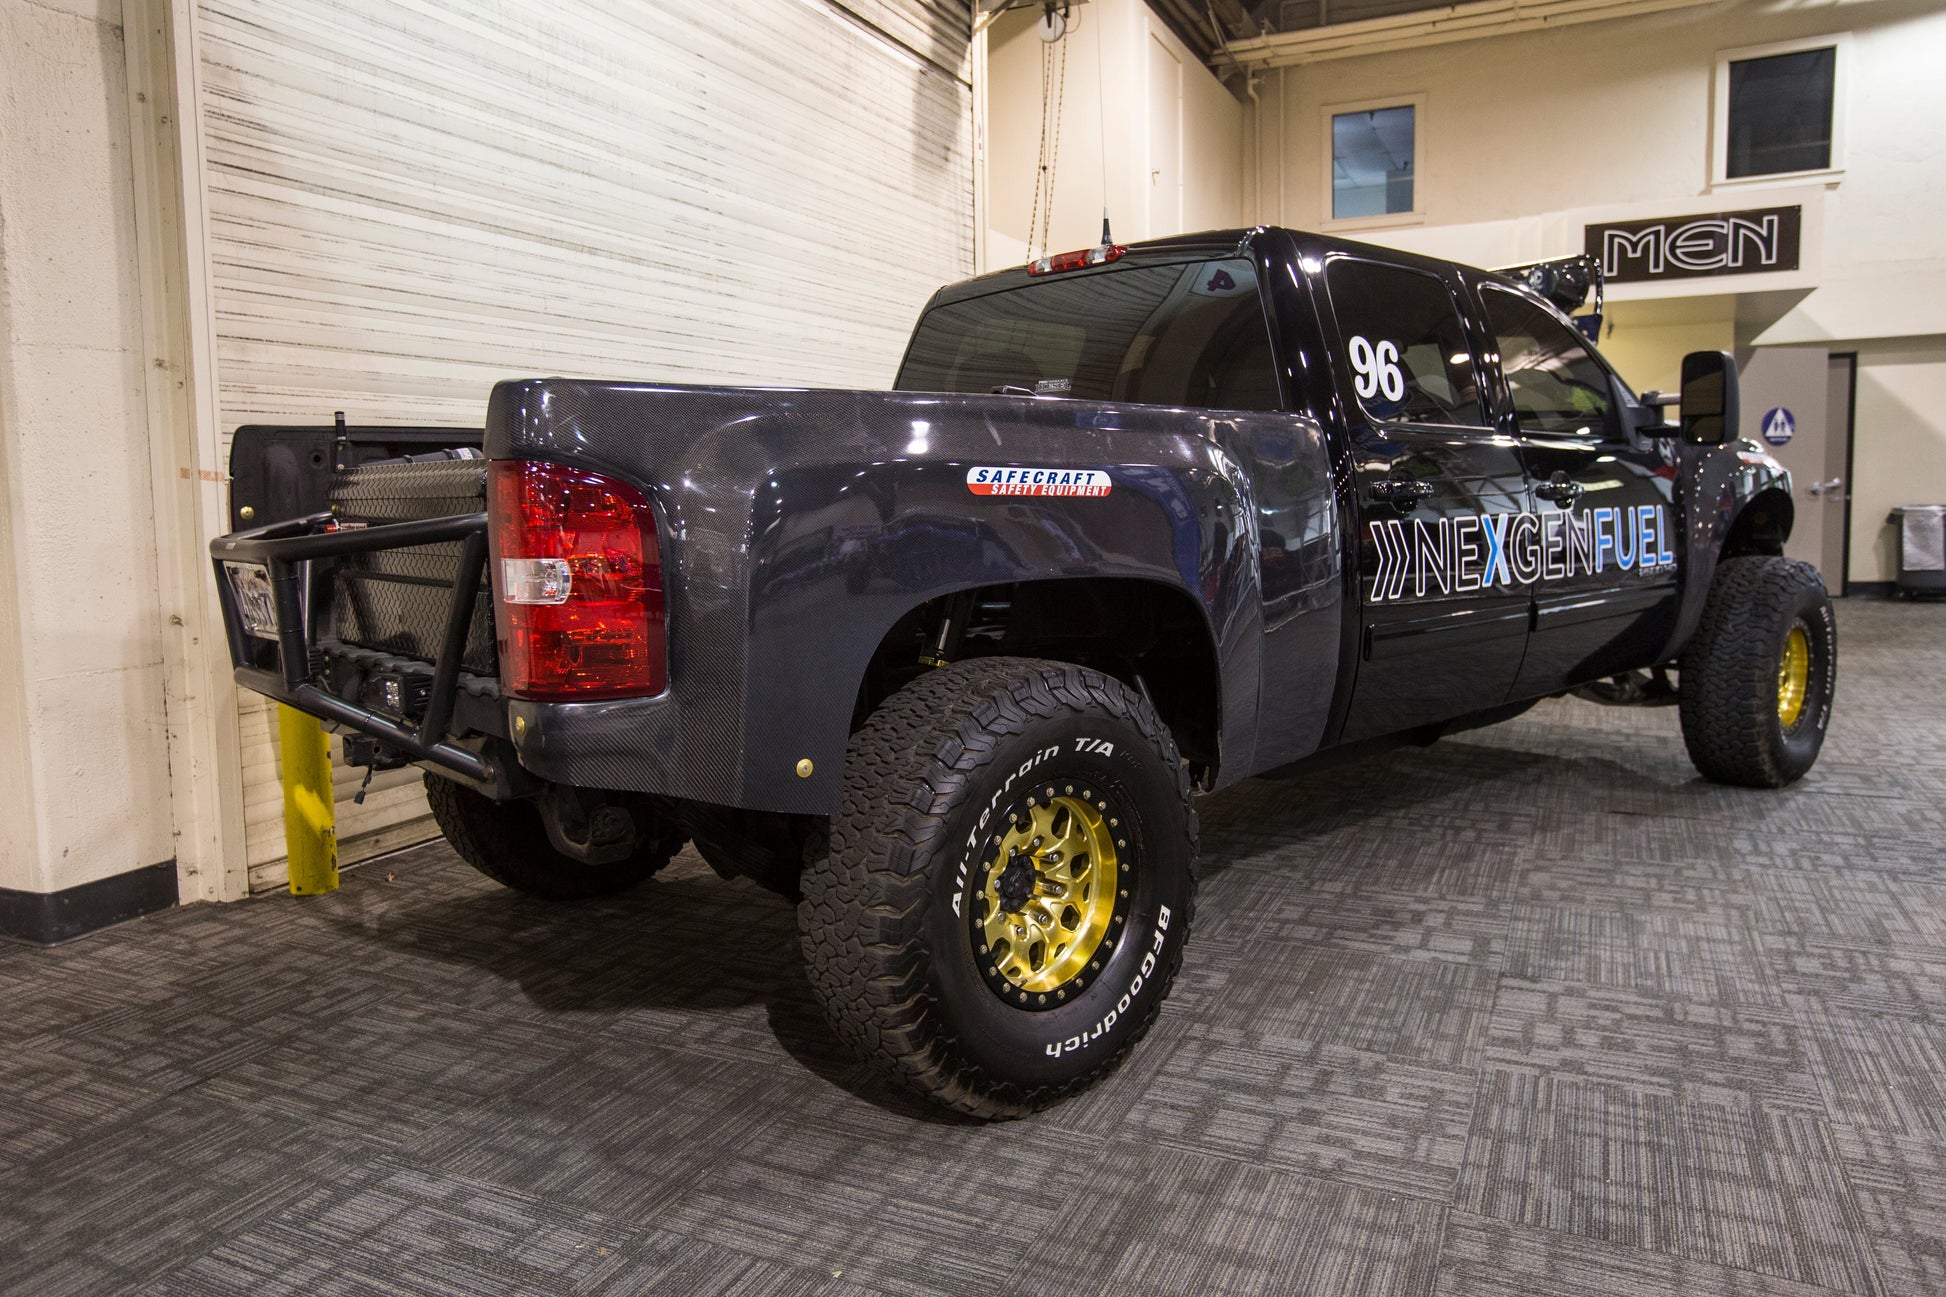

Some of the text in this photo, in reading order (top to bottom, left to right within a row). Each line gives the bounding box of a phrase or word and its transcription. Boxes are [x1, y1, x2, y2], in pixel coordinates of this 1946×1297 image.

[1603, 215, 1779, 277] MEN
[1348, 335, 1405, 402] 96
[976, 469, 1095, 485] SAFECRAFT
[991, 484, 1107, 496] SAFETY EQUIPMENT
[952, 737, 1115, 918] All-Terrain T/A
[1045, 904, 1172, 1059] BFGoodrich
